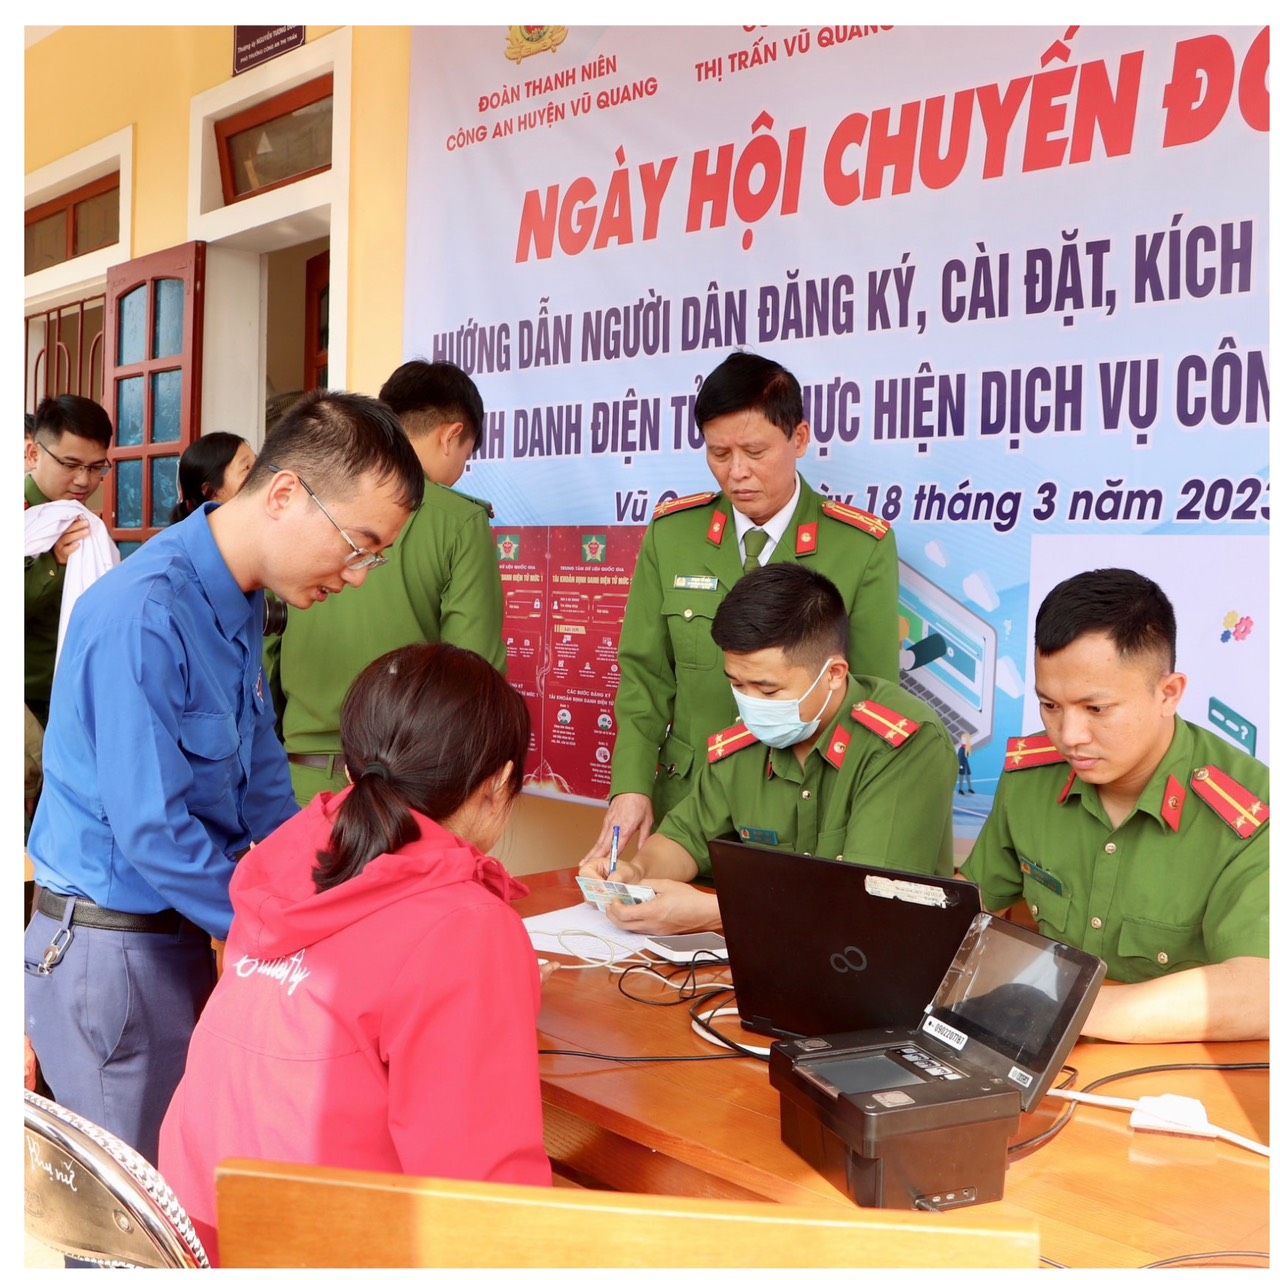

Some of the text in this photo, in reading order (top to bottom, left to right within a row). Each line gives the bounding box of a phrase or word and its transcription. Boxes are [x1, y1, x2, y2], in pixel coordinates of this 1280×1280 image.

[478, 55, 617, 112] ĐOÀN THANH NIÊN
[695, 59, 723, 82] THỊ
[728, 37, 777, 72] TRẤN
[784, 26, 810, 55] VŨ
[446, 77, 658, 151] CÔNG AN HUYỆN VŨ QUANG
[515, 145, 678, 263] NGÀY
[685, 109, 806, 250] HỘI
[433, 214, 1254, 376] HƯỚNG DẪN NGƯỜI DÂN ĐĂNG KÝ, CÀI ĐẶT, KÍCH
[513, 403, 581, 458] DANH
[591, 388, 659, 465] ĐIỆN
[873, 362, 966, 453] HIỆN
[981, 364, 1082, 449] DỊCH
[1099, 359, 1159, 445] VỤ
[615, 490, 649, 523] Vũ
[866, 484, 901, 520] 18
[913, 480, 1021, 532] tháng
[1033, 482, 1057, 520] 3
[1068, 479, 1163, 520] năm
